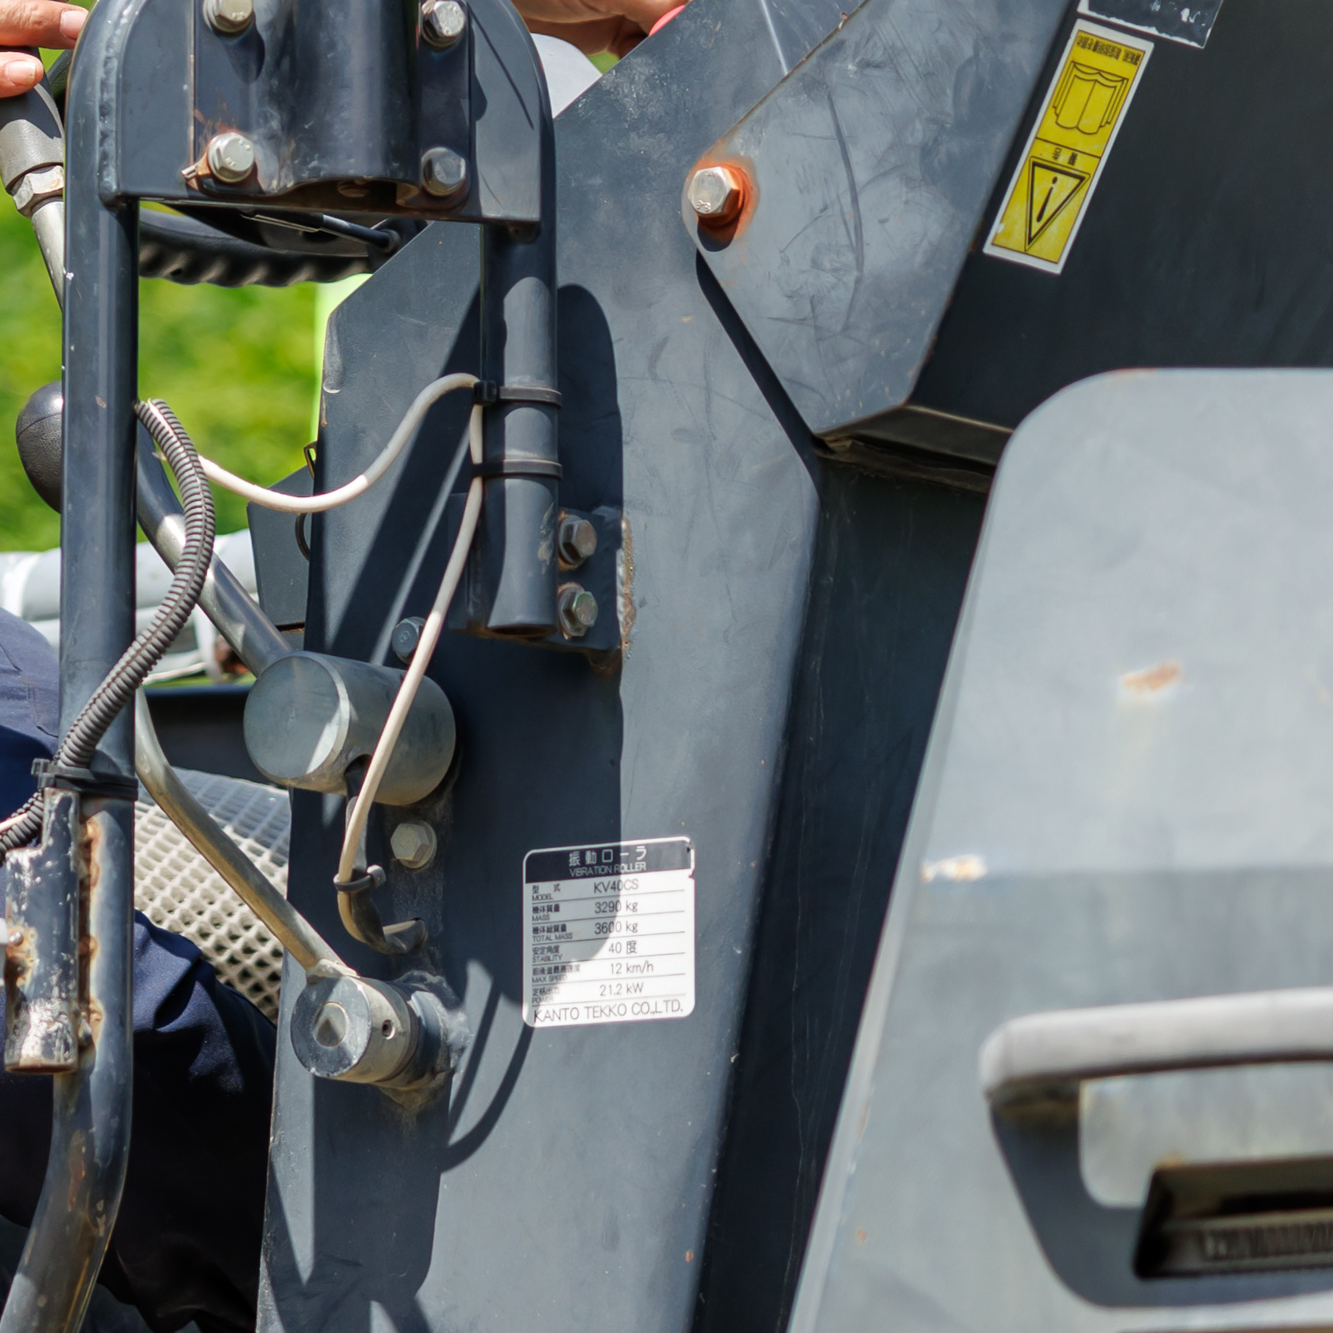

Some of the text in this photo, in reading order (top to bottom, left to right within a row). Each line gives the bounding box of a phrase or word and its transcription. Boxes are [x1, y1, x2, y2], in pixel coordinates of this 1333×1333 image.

[568, 845, 647, 867] 振動ローラ
[569, 862, 647, 877] VIBRATION ROLLER
[593, 878, 639, 894] KV40CS
[532, 893, 554, 901] MODEL
[594, 900, 638, 915] 3290 kg
[532, 914, 551, 922] MASS
[594, 921, 638, 935] 3600 kg
[532, 932, 573, 943] TOTAL MASS
[608, 940, 638, 955] 40 度
[532, 954, 563, 963] STABILITY
[610, 960, 654, 975] 12 km/h
[532, 973, 568, 984] MAX SPEED
[599, 982, 644, 997] 21.2 kW
[533, 1006, 580, 1023] KANTO
[584, 1002, 627, 1019] TEKKO
